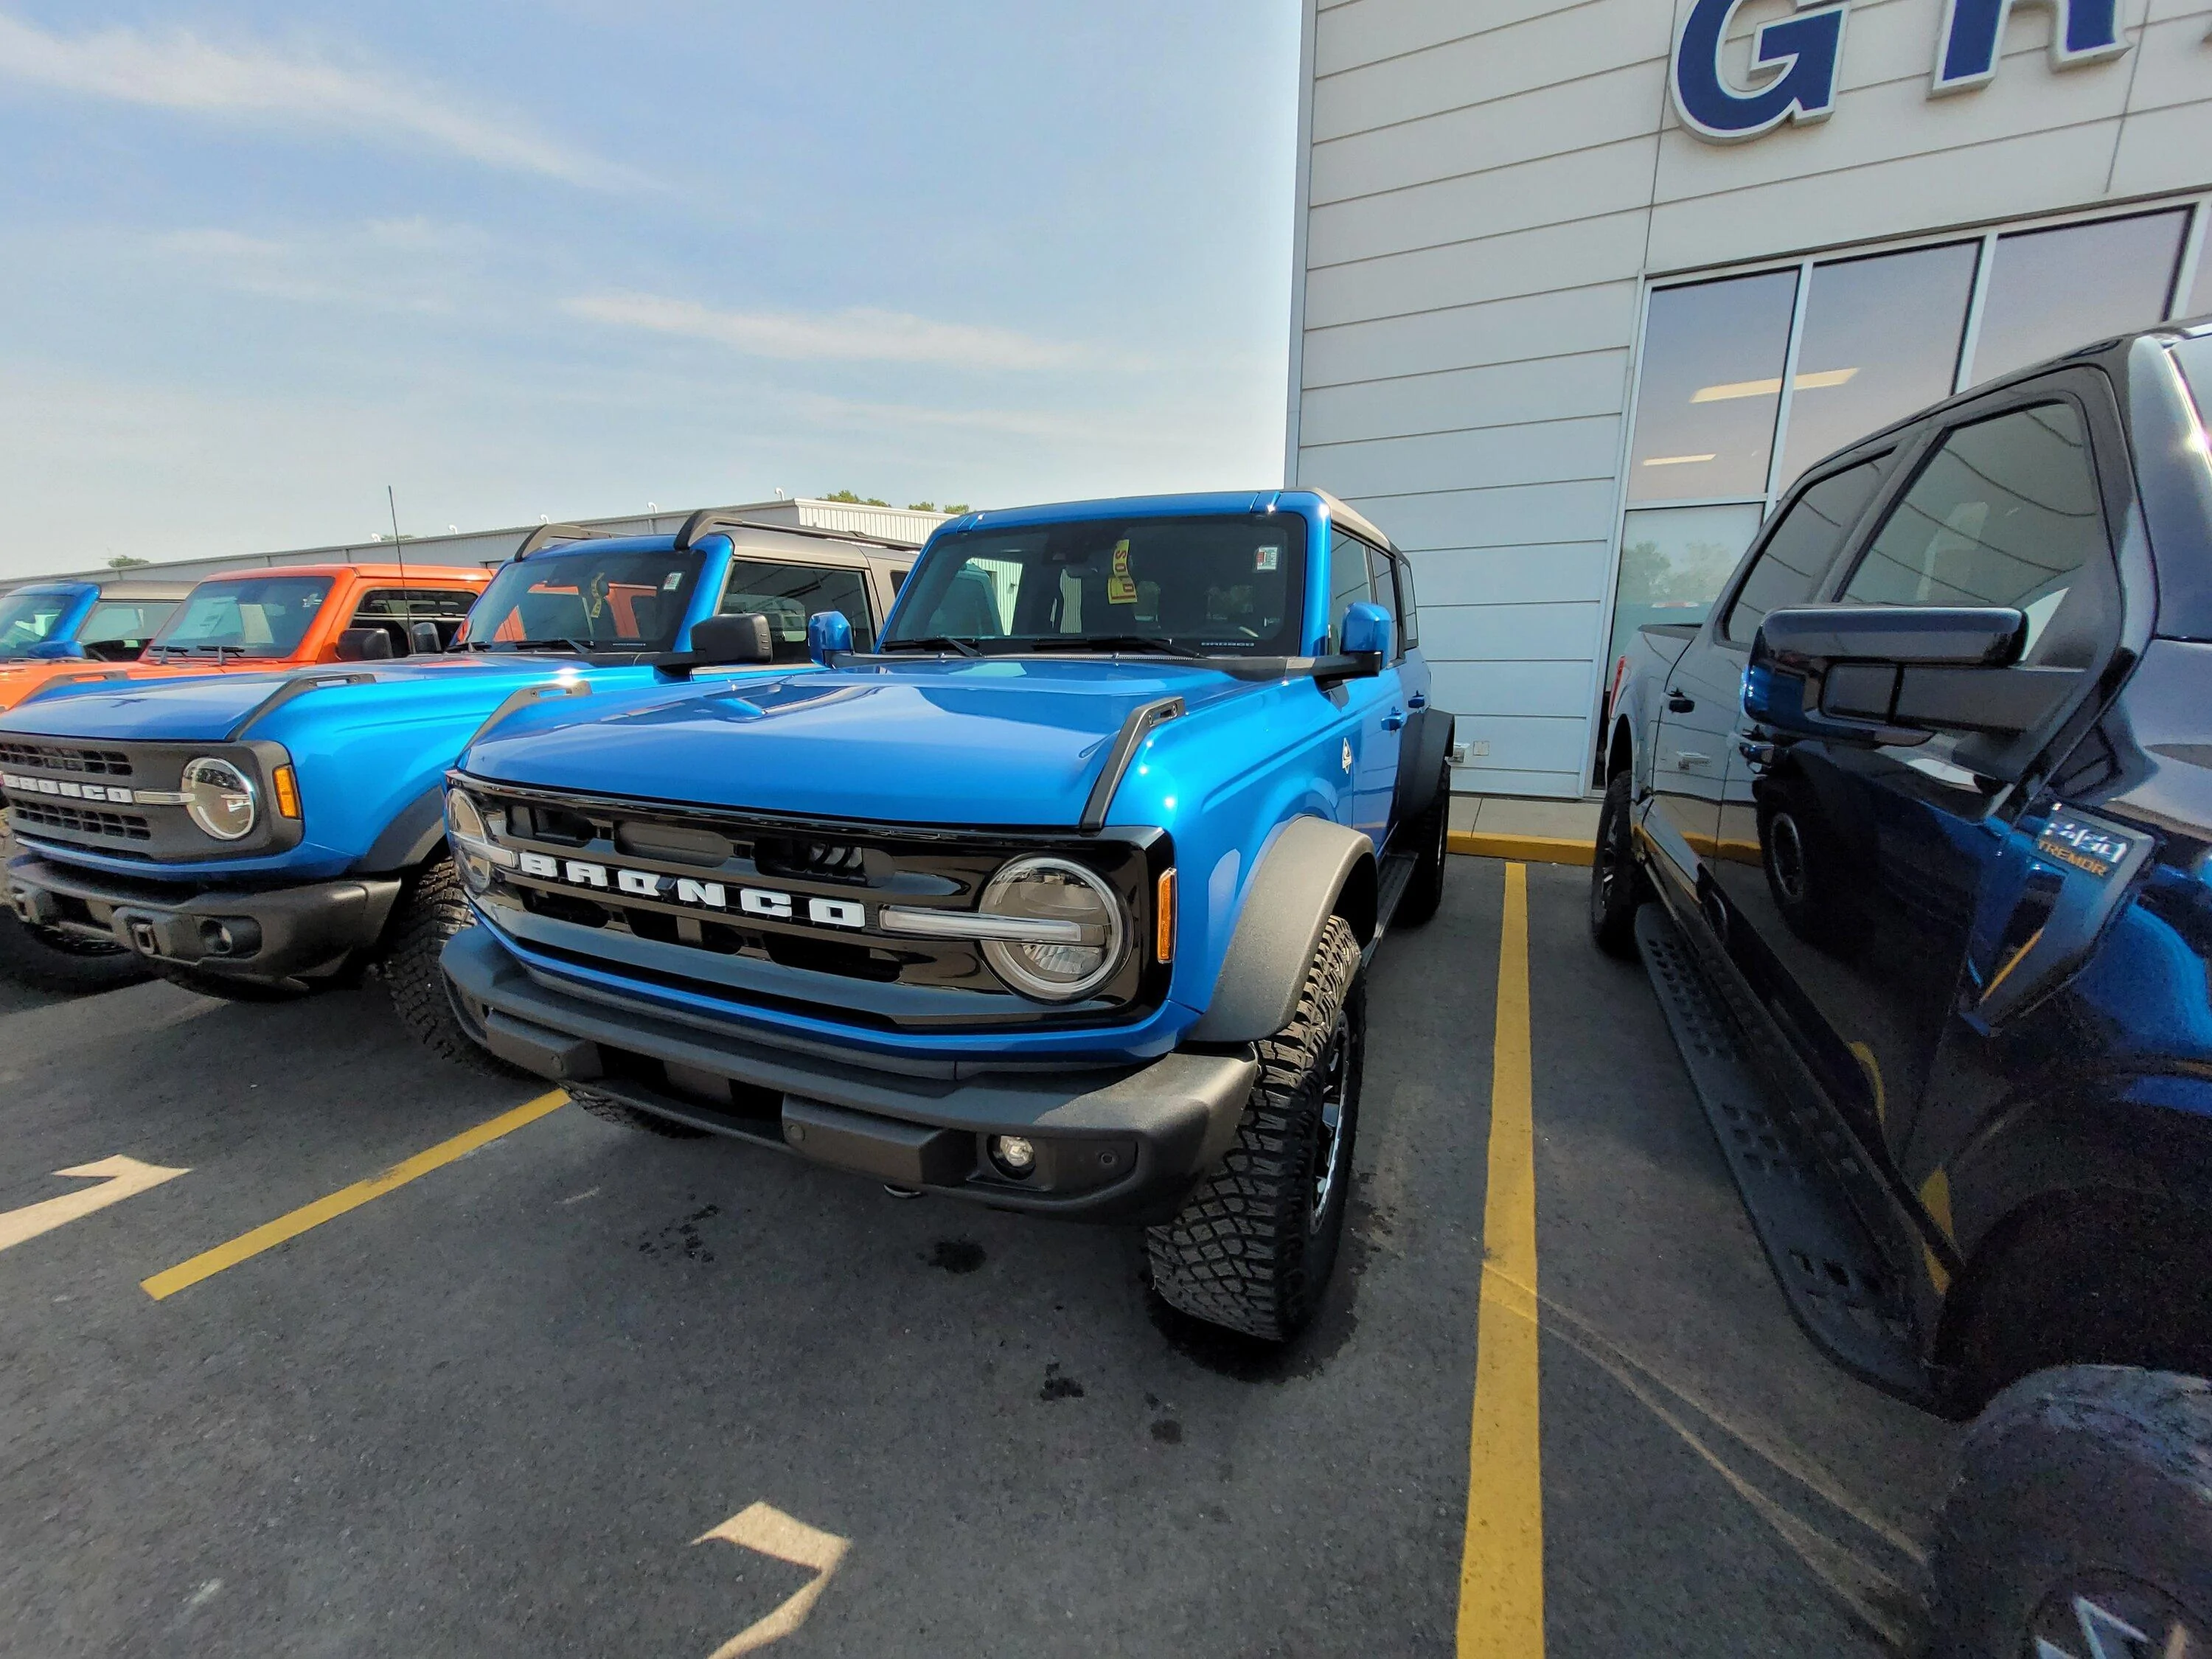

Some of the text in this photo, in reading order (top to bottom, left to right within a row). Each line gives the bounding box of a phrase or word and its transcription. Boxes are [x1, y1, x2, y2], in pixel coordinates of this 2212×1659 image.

[1115, 551, 1134, 593] SOLD
[2039, 840, 2107, 876] TREMOR
[520, 851, 866, 928] BRONCO
